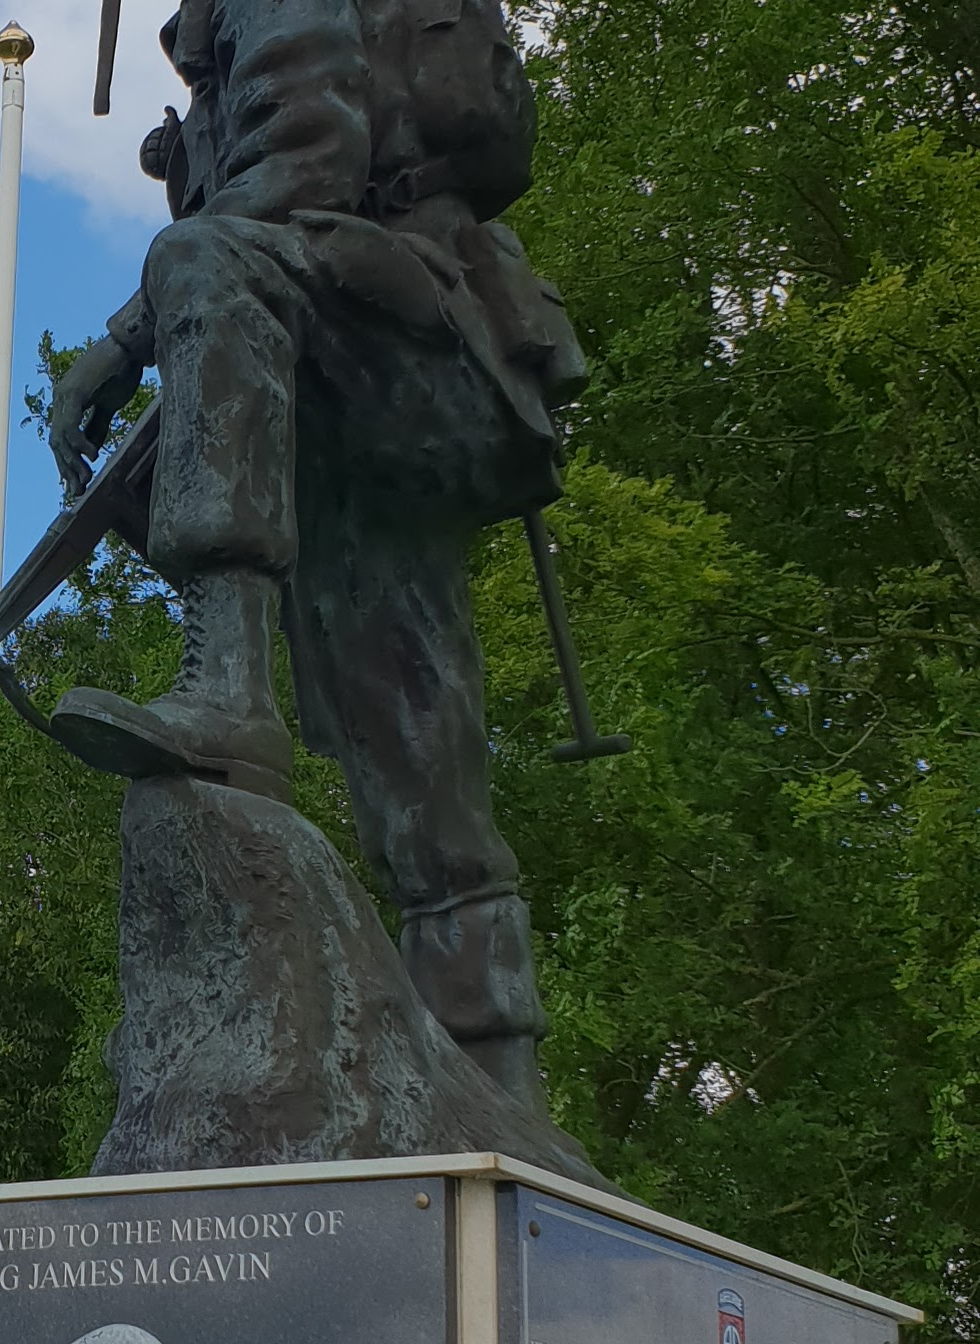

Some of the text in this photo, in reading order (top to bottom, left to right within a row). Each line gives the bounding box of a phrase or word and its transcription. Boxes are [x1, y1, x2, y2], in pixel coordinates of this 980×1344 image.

[62, 1222, 100, 1248] TO
[106, 1219, 162, 1246] THE
[170, 1211, 298, 1243] MEMORY
[304, 1209, 345, 1237] OF
[27, 1258, 125, 1291] JAMES
[133, 1251, 270, 1285] M.GAVIN
